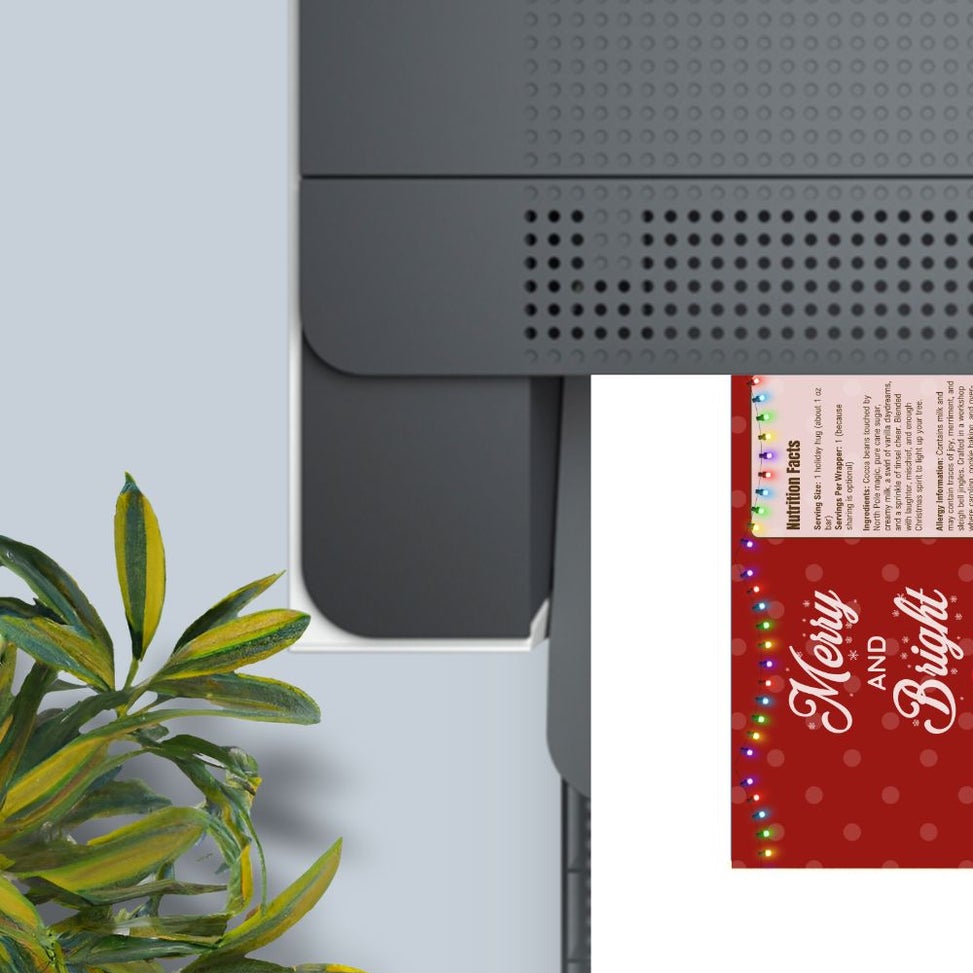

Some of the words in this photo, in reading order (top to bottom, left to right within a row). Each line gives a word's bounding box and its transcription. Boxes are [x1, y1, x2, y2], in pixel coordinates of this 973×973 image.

[815, 388, 822, 396] oz
[863, 395, 872, 405] by
[884, 381, 892, 423] daydreams,
[957, 386, 966, 422] workshop
[814, 405, 822, 428] (about
[835, 404, 843, 436] (because
[863, 406, 872, 435] touched
[873, 404, 882, 426] sugar,
[905, 402, 913, 429] enough
[915, 417, 924, 434] your
[814, 431, 822, 445] hug
[863, 438, 872, 459] beans
[916, 436, 924, 445] up
[936, 424, 945, 456] Contains
[947, 438, 955, 452] joy,
[786, 440, 800, 473] Facts
[814, 447, 822, 472] holiday
[835, 447, 843, 481] Wrapper:
[873, 448, 882, 464] pure
[915, 448, 924, 463] light
[957, 439, 966, 465] Crafted
[845, 462, 854, 493] optional)
[863, 461, 871, 483] Cocoa
[915, 475, 924, 493] spirit
[936, 458, 945, 503] Information:
[947, 463, 955, 485] traces
[957, 468, 966, 493] jingles.
[786, 478, 800, 530] Nutrition
[894, 481, 903, 509] sprinkle
[905, 482, 913, 514] laughter,
[814, 502, 822, 530] Serving
[835, 498, 843, 530] Servings
[845, 504, 854, 530] sharing
[863, 486, 872, 531] Ingredients:
[884, 505, 892, 531] creamy
[915, 495, 924, 531] Christmas
[936, 505, 945, 531] Allergy
[957, 509, 966, 531] sleigh
[824, 515, 833, 530] bar)
[905, 516, 913, 531] with
[947, 516, 955, 531] may
[788, 589, 859, 734] Merry
[867, 636, 887, 690] AND
[893, 586, 964, 735] Bright
